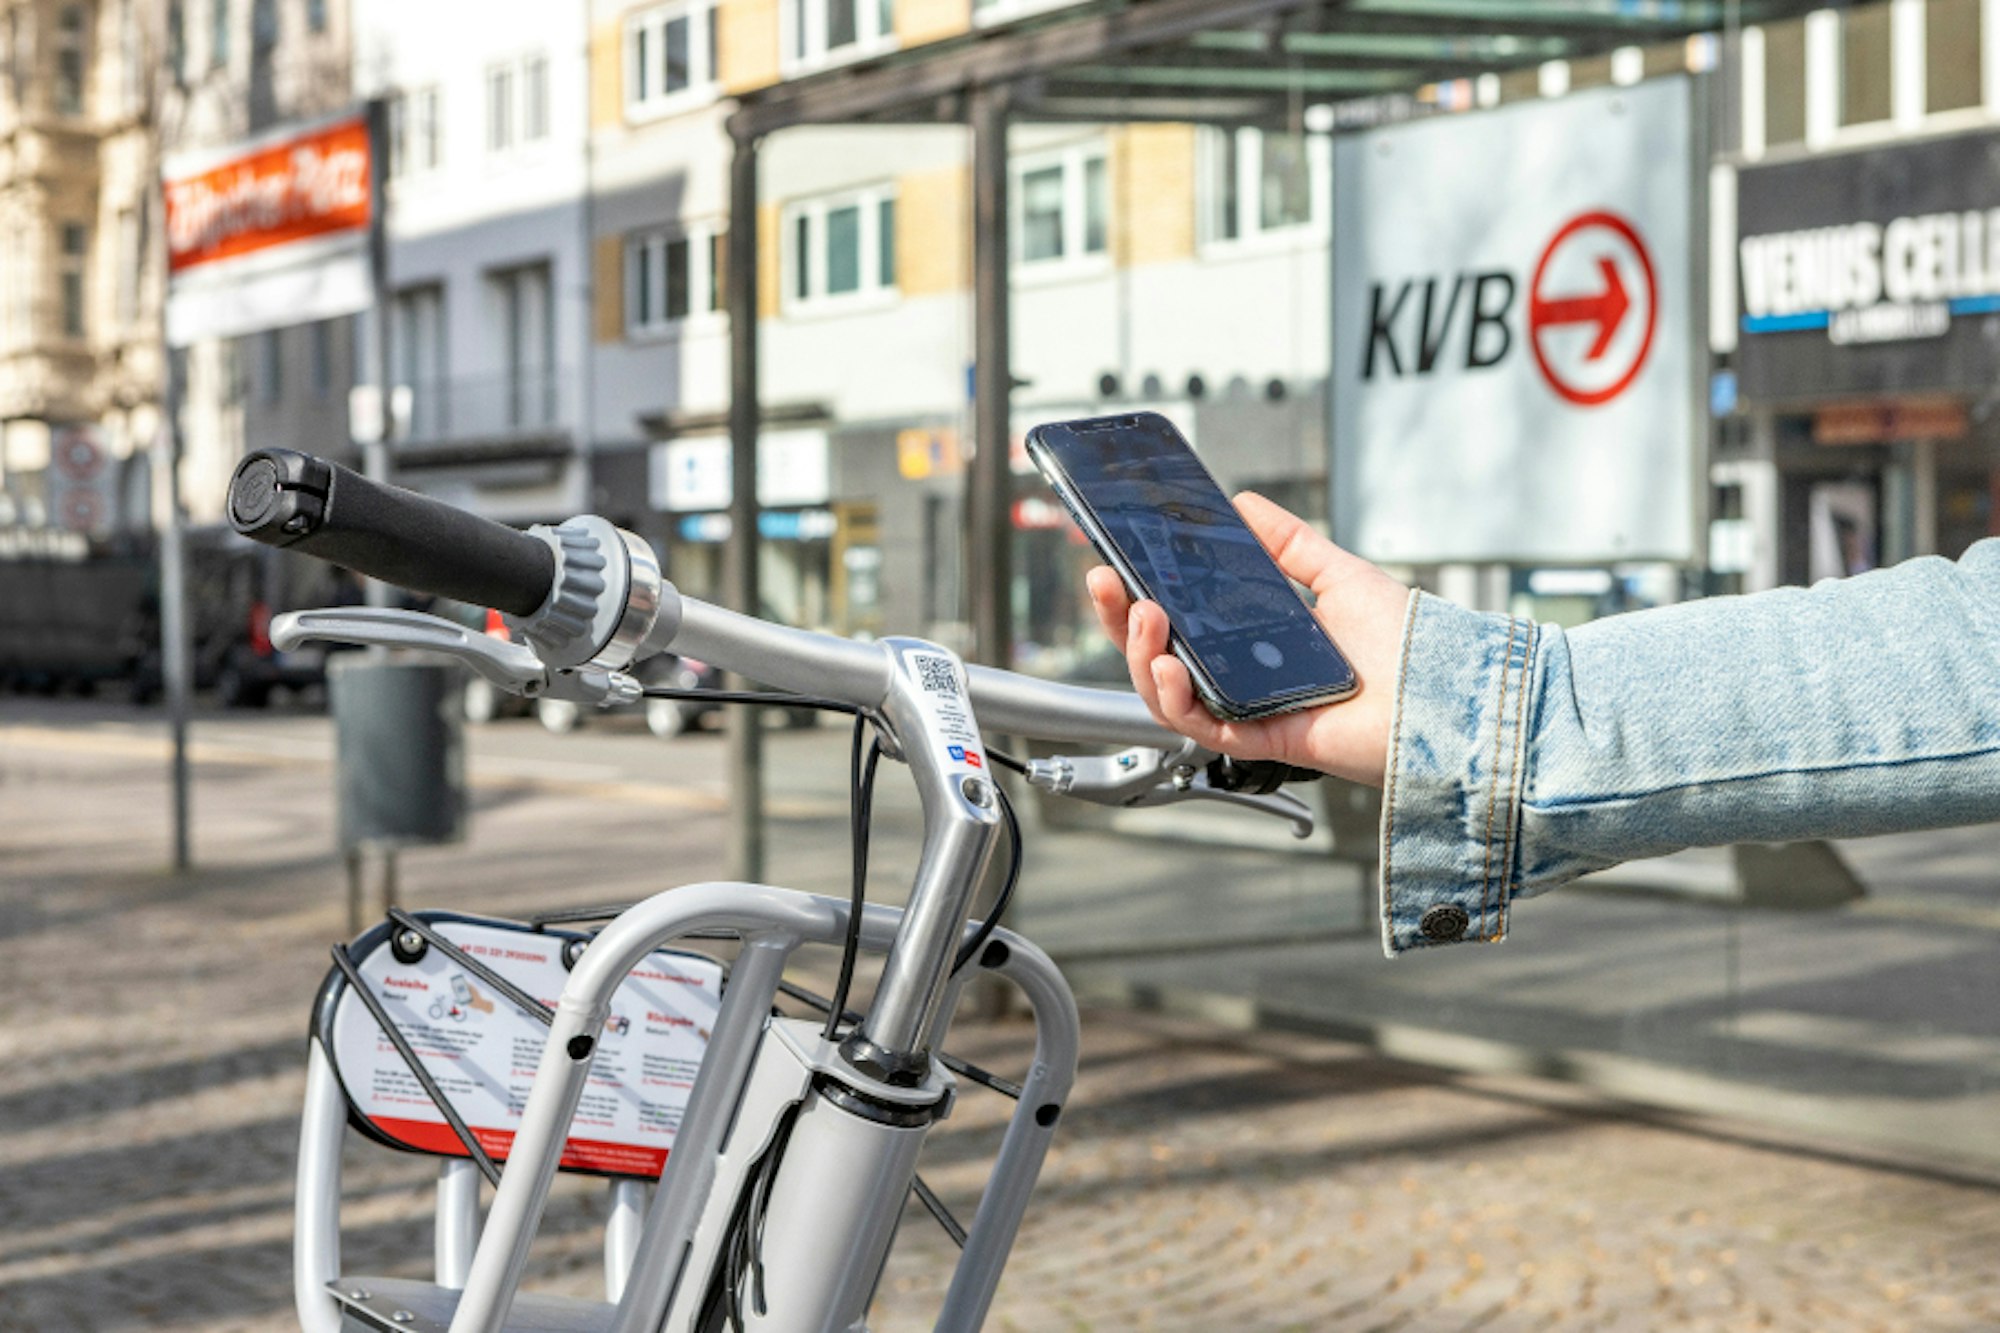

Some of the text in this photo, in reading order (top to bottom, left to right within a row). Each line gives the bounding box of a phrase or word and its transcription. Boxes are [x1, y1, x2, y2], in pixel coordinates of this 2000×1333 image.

[1740, 221, 1883, 317] VENUS
[1361, 268, 1517, 379] KVB
[384, 976, 429, 991] Ausleihe
